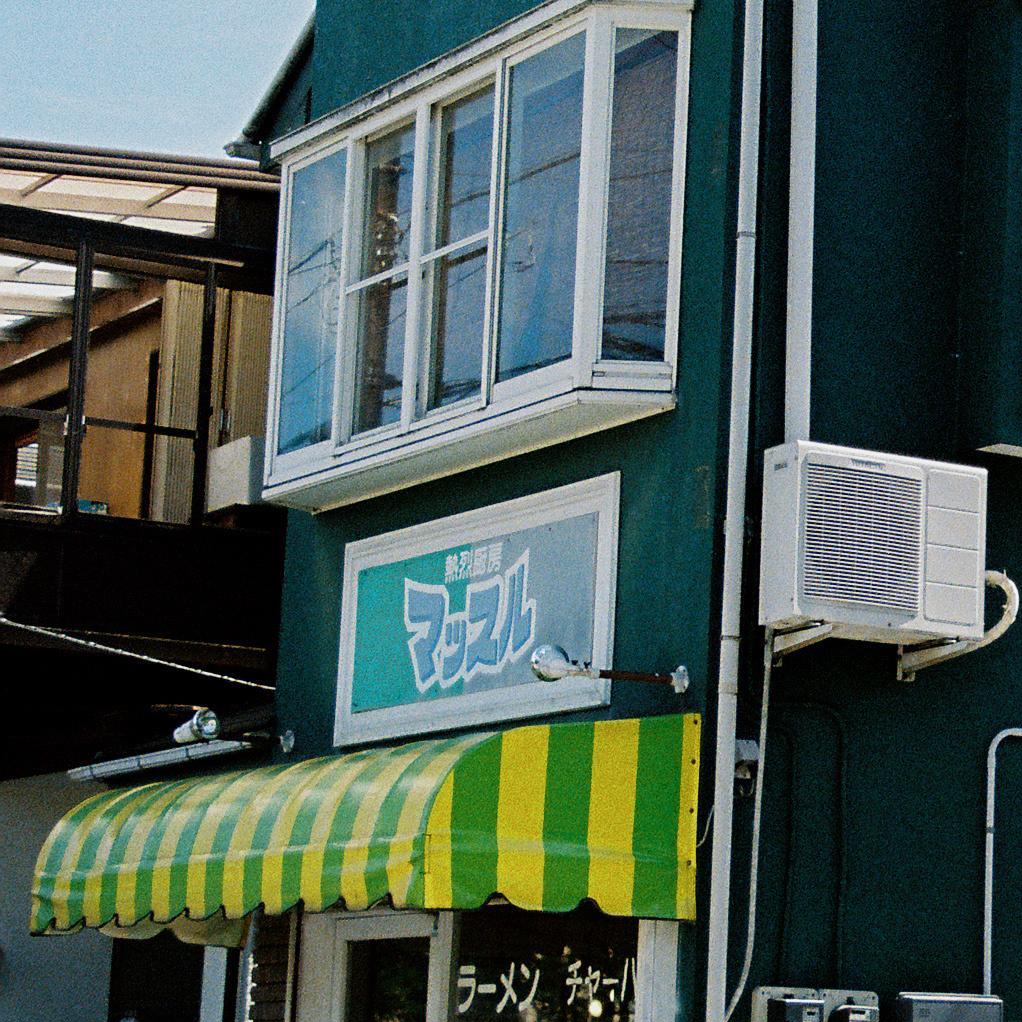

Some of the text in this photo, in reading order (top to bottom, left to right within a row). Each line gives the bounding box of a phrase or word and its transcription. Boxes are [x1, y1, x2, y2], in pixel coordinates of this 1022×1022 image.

[404, 548, 536, 693] マッスル
[457, 962, 540, 1013] ラーメン
